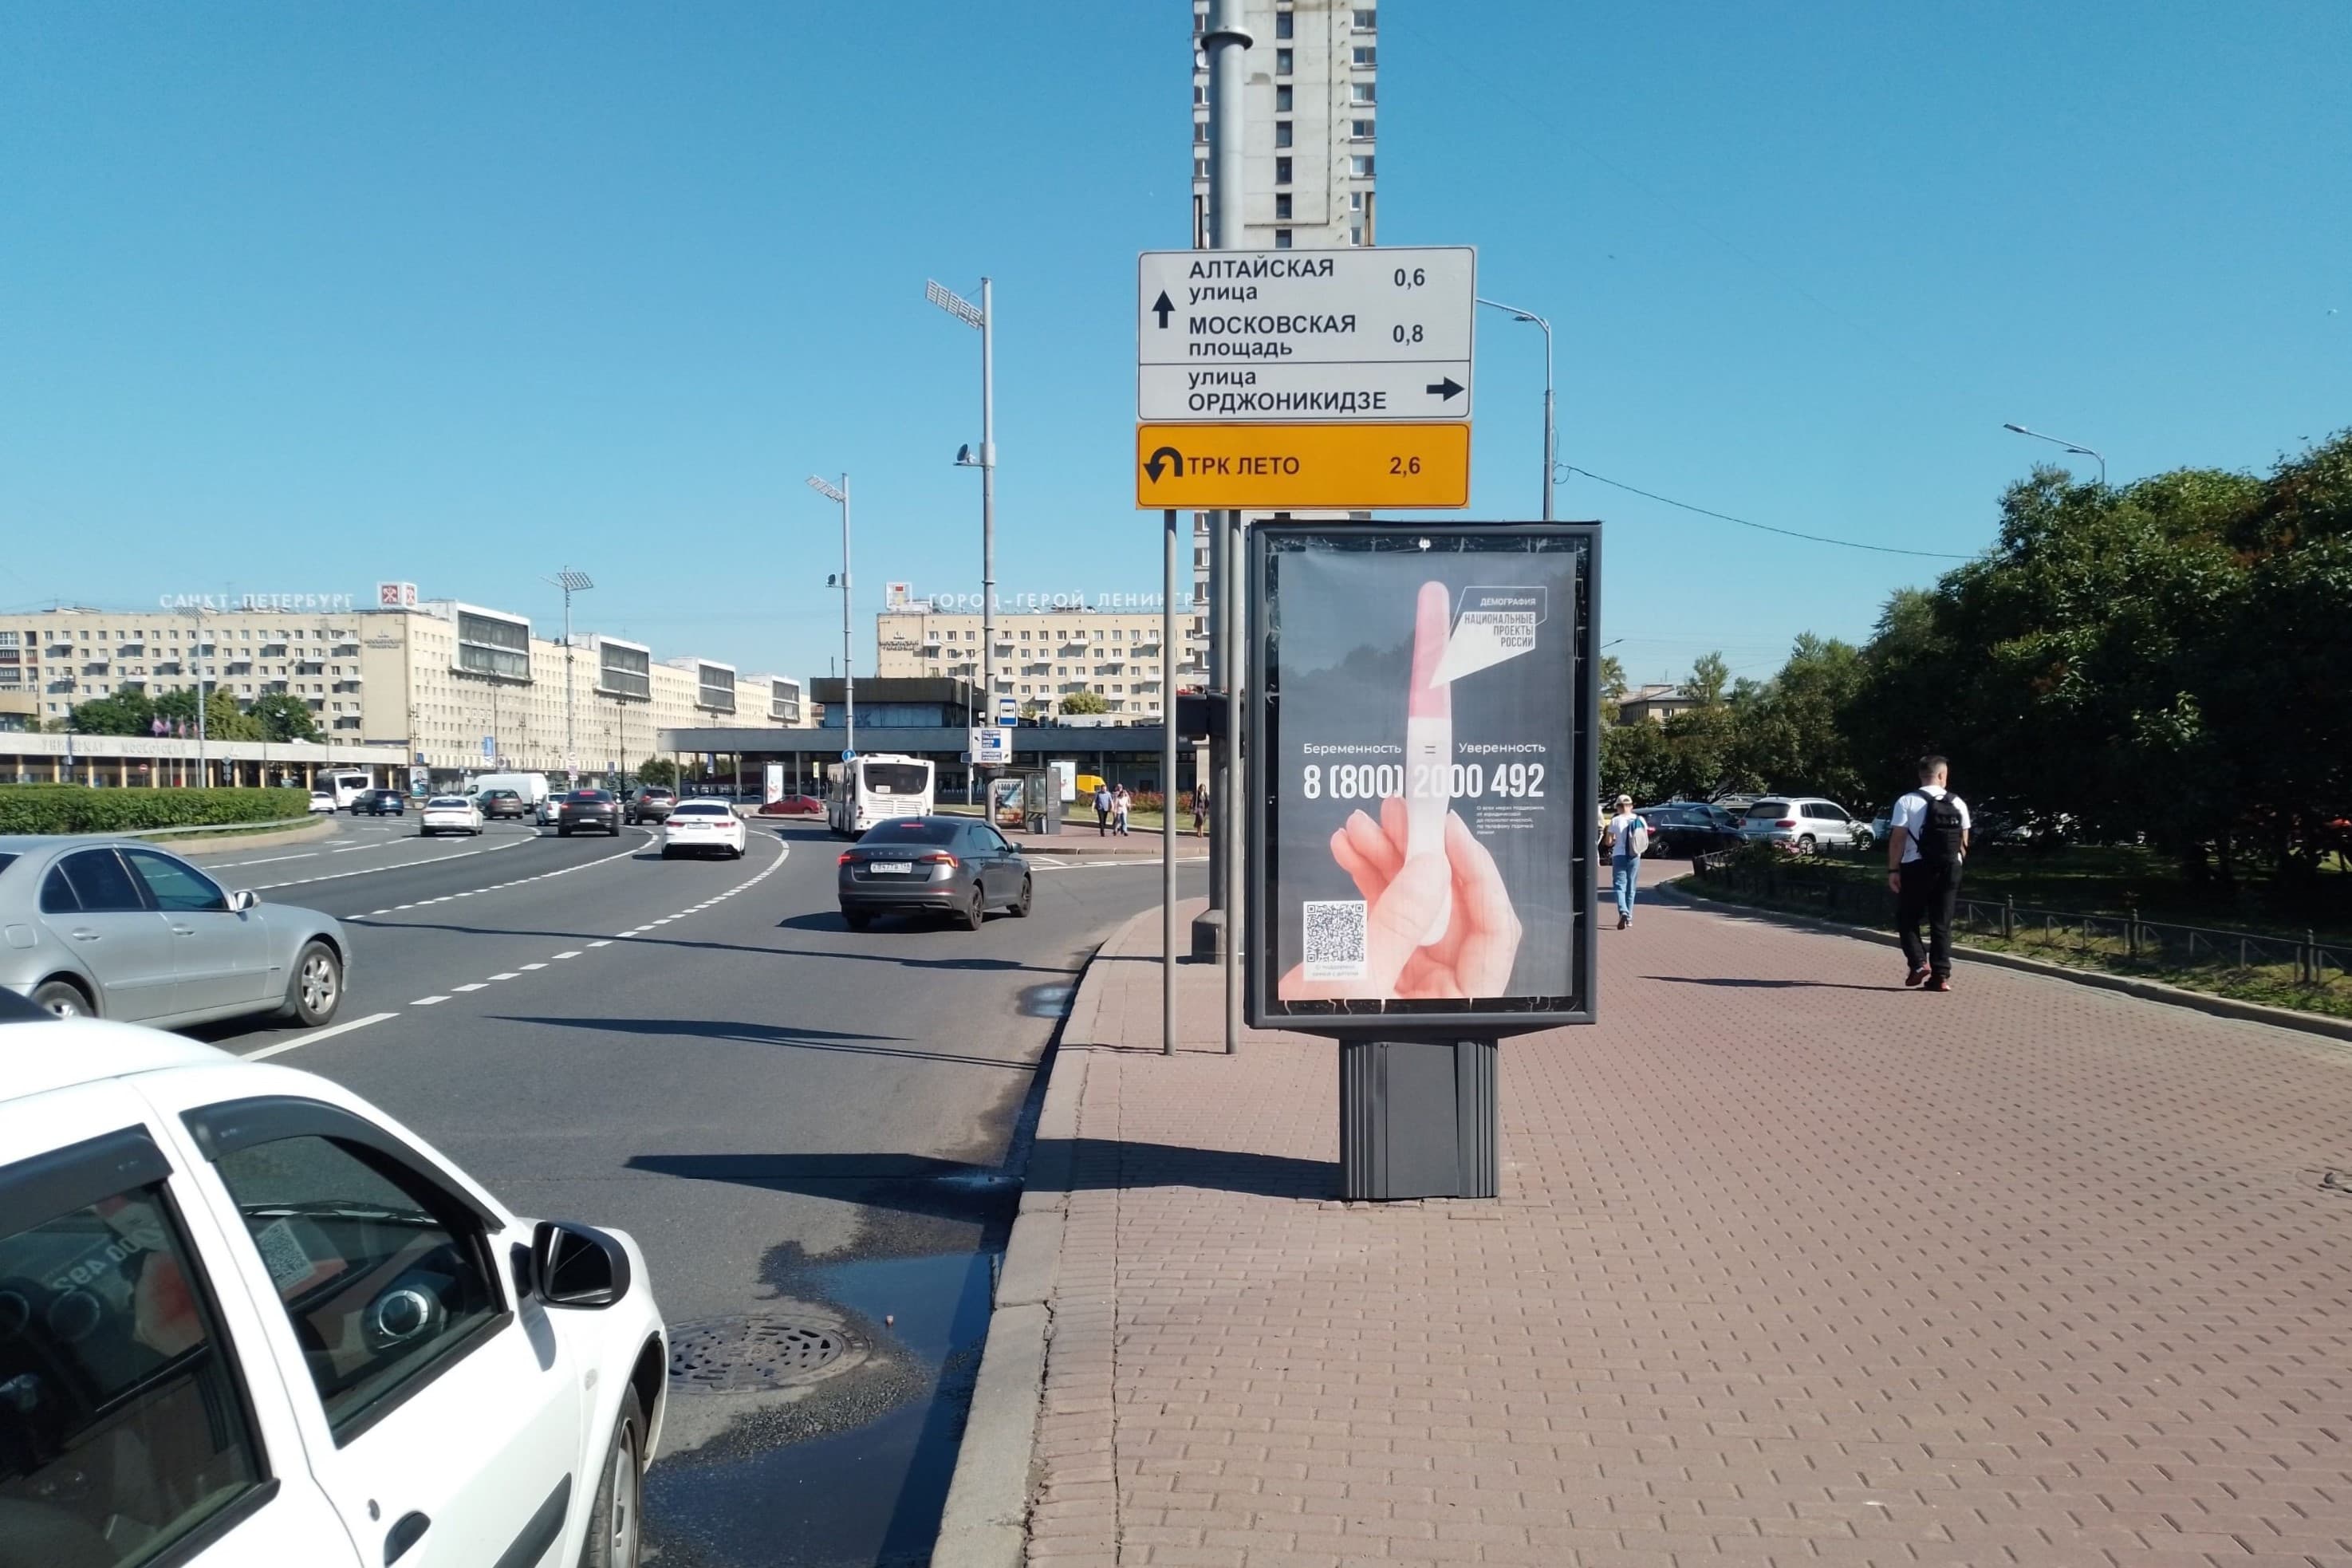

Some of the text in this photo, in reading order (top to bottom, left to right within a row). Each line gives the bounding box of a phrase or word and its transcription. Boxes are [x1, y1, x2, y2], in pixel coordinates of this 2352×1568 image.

[1189, 255, 1334, 279] АЛТАЙСКАЯ
[1393, 268, 1425, 290] 0,6
[1189, 283, 1258, 305] улица
[1189, 314, 1357, 335] МОСКОВСКАЯ
[1393, 324, 1424, 347] 0,8
[1189, 341, 1293, 358] площадь
[1188, 370, 1257, 389] улица
[1188, 392, 1387, 414] ОРДЖОНИКИДЗЕ
[1188, 457, 1300, 475] ТРК ЛЕТО
[1389, 456, 1421, 479] 2,6
[1479, 597, 1536, 607] ДЕМОГРАФИЯ
[1464, 613, 1533, 625] НАЦИОНАЛЬНЫЕ
[1493, 625, 1534, 636] ПРОЕКТЫ
[1500, 636, 1534, 647] РОССИИ
[1303, 743, 1402, 756] Беременность
[1459, 742, 1546, 754] Уверенность
[1303, 763, 1545, 799] 8 (800) 2000 492
